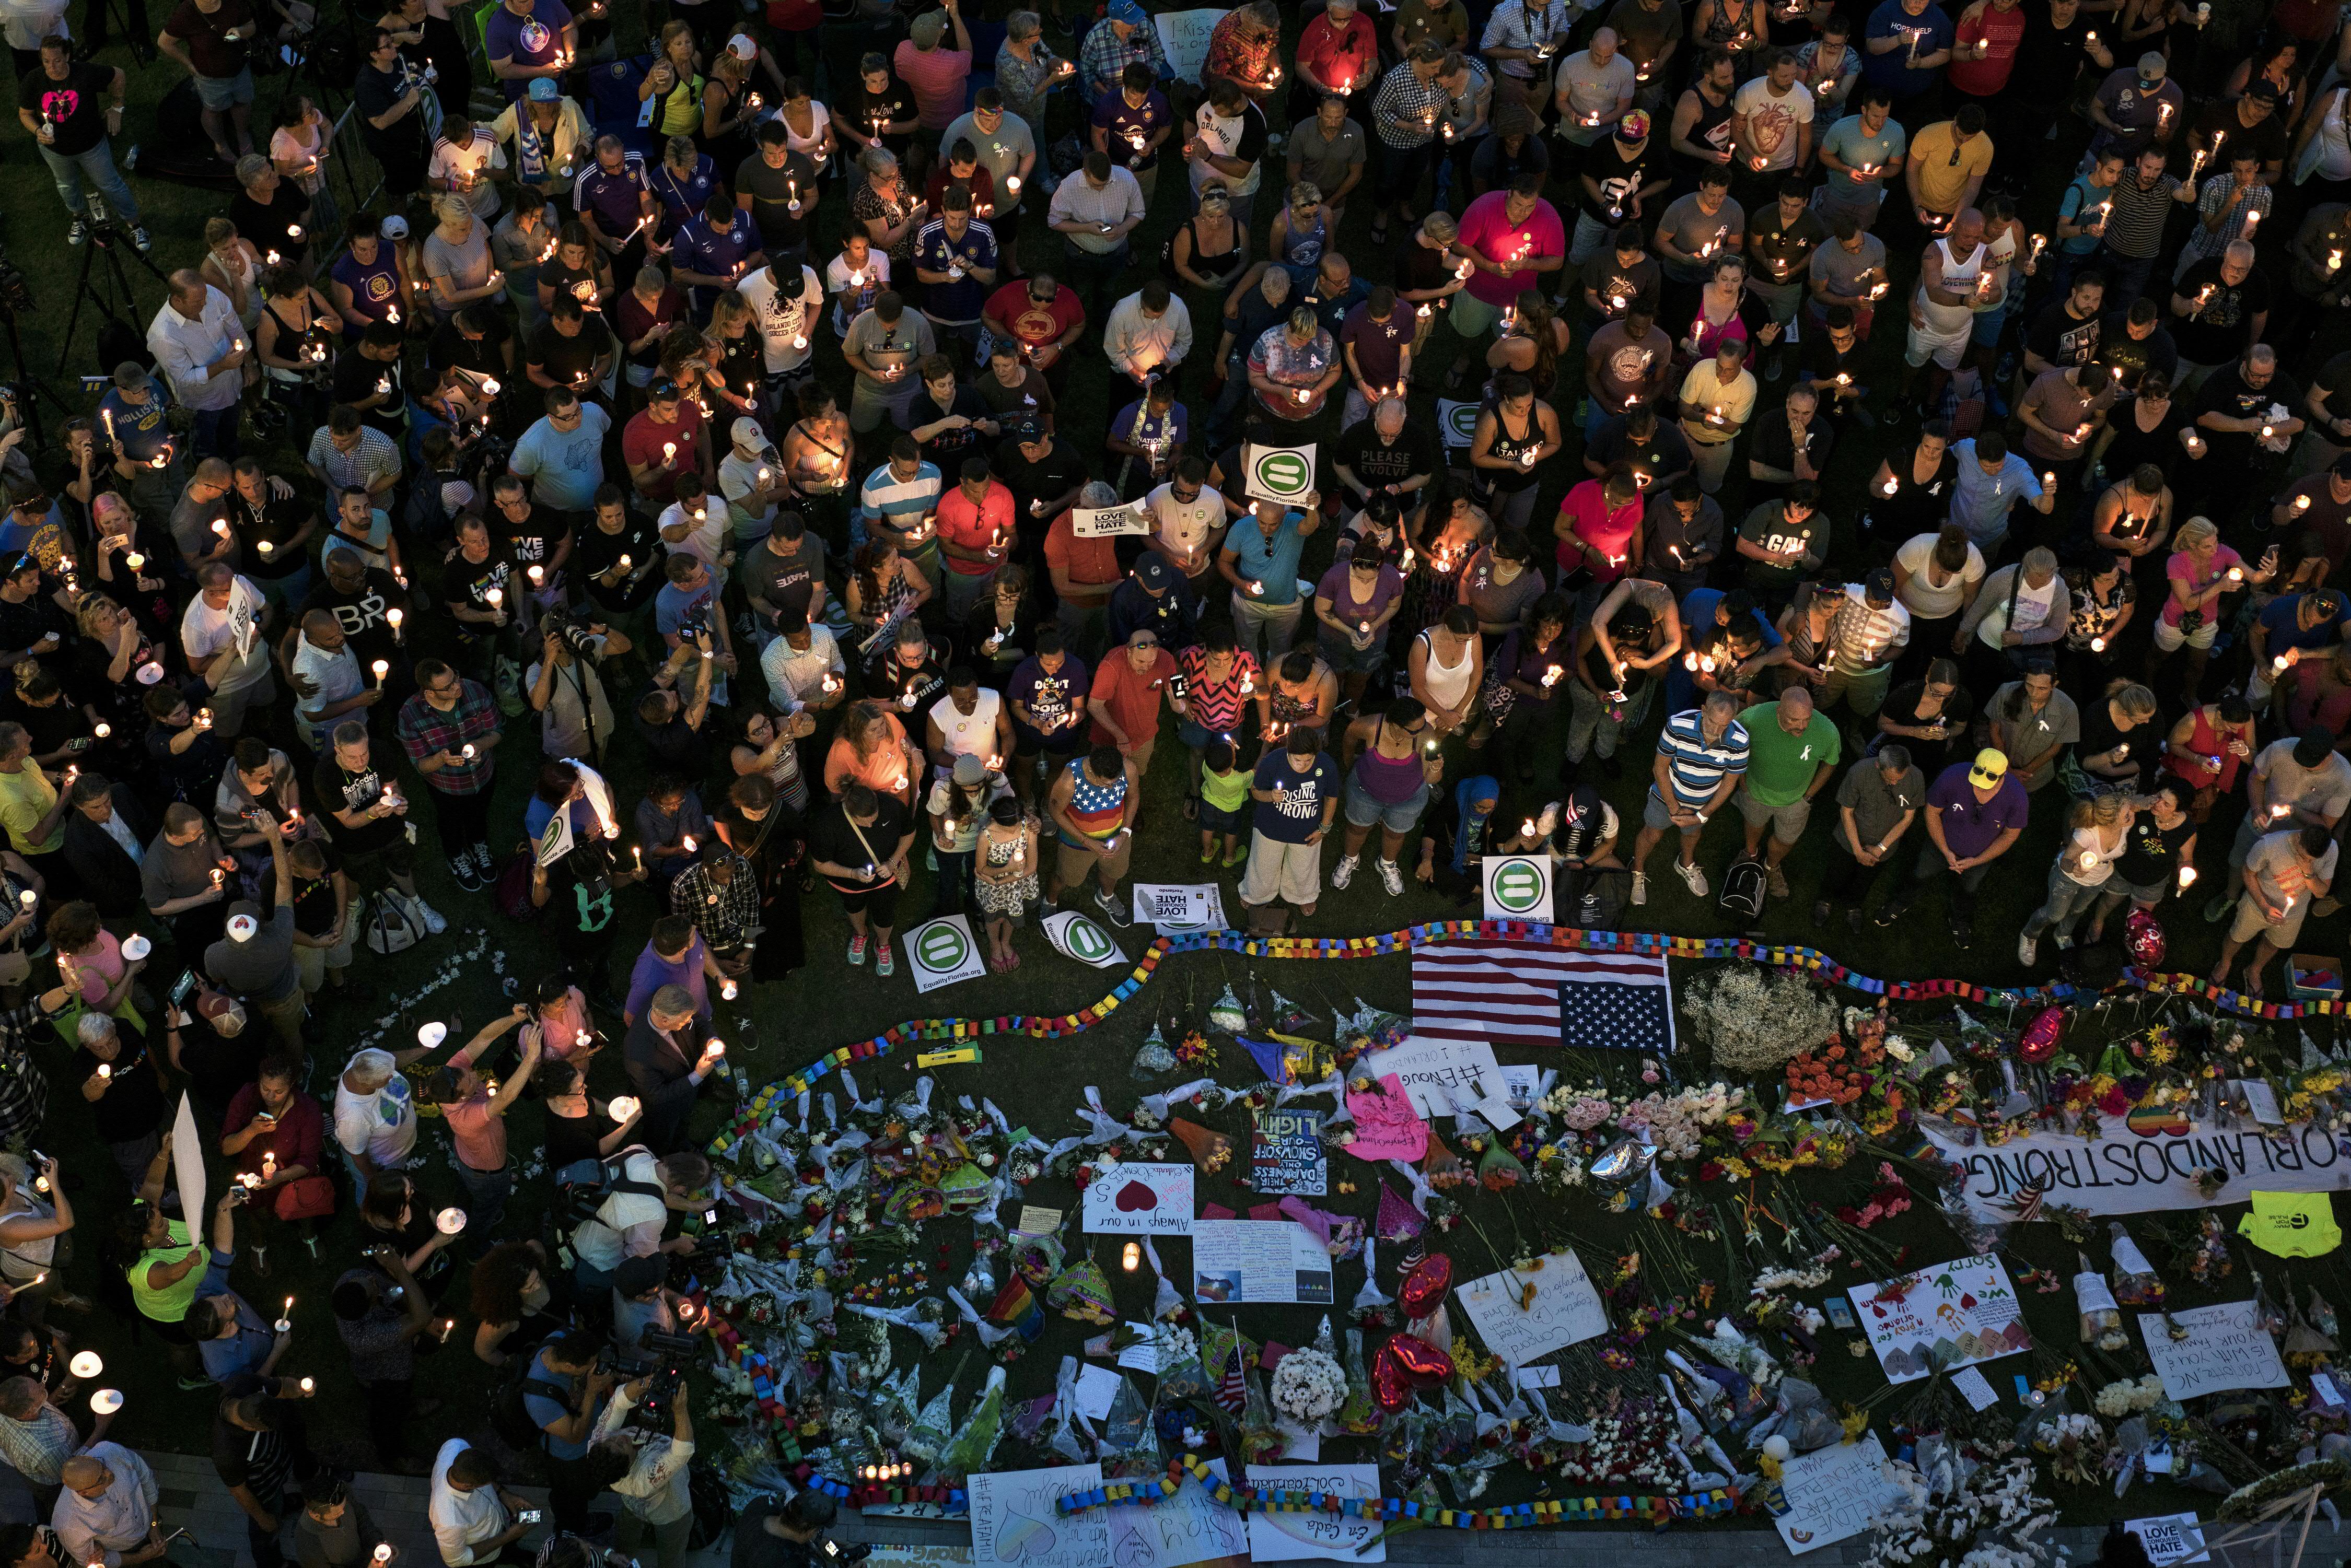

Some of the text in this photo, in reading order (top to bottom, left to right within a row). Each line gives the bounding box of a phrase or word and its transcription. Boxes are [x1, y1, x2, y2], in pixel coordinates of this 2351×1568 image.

[1169, 42, 1186, 51] The
[1201, 123, 1230, 145] ORLANDO
[766, 317, 802, 331] ORLANDO CITY
[769, 323, 802, 337] SOCCER CLUB
[117, 393, 160, 425] HOLLISTER
[1361, 450, 1410, 463] PLEASE
[1361, 465, 1409, 476] EVOLVE
[1251, 490, 1310, 508] EqualityFlorida.org
[1095, 512, 1126, 521] LOVE
[1095, 521, 1127, 530] HATE
[1766, 534, 1806, 555] GAY
[775, 570, 808, 588] HATE
[1031, 703, 1067, 713] POKE
[342, 771, 378, 794] BarCodes
[1282, 787, 1316, 802] RISING
[1212, 887, 1223, 928] EqualityFlorida.org
[923, 968, 982, 988] EqualityFlorida.org
[1387, 1049, 1438, 1069] ORLANDO
[1401, 1063, 1484, 1088] #ENOUG
[1255, 1115, 1317, 1137] LIGHT
[1279, 1137, 1304, 1145] OUR
[1279, 1161, 1302, 1169] ONLY
[1254, 1166, 1317, 1182] DARKNESS
[1261, 1177, 1286, 1186] THEIR
[1099, 1207, 1189, 1232] Always in our
[1556, 1291, 1567, 1302] we
[1978, 1288, 2009, 1300] We
[1554, 1292, 1592, 1316] together
[1480, 1304, 1512, 1321] Christ
[1494, 1317, 1533, 1339] Street
[1509, 1326, 1571, 1362] Concord
[1877, 1332, 1892, 1343] for
[1962, 1335, 1976, 1355] FAMILY
[2216, 1330, 2257, 1347] YOUR
[2179, 1351, 2208, 1365] YOU
[2251, 1345, 2265, 1357] IS
[1886, 1355, 1907, 1365] PULSE
[1793, 1475, 1882, 1524] #ONEHEART
[1153, 1515, 1234, 1549] Stay
[1306, 1520, 1368, 1540] En Cada
[2144, 1526, 2179, 1539] LOVE
[2147, 1536, 2180, 1544] CONQUERS
[2149, 1541, 2183, 1554] HATE
[1074, 1548, 1108, 1567] even
